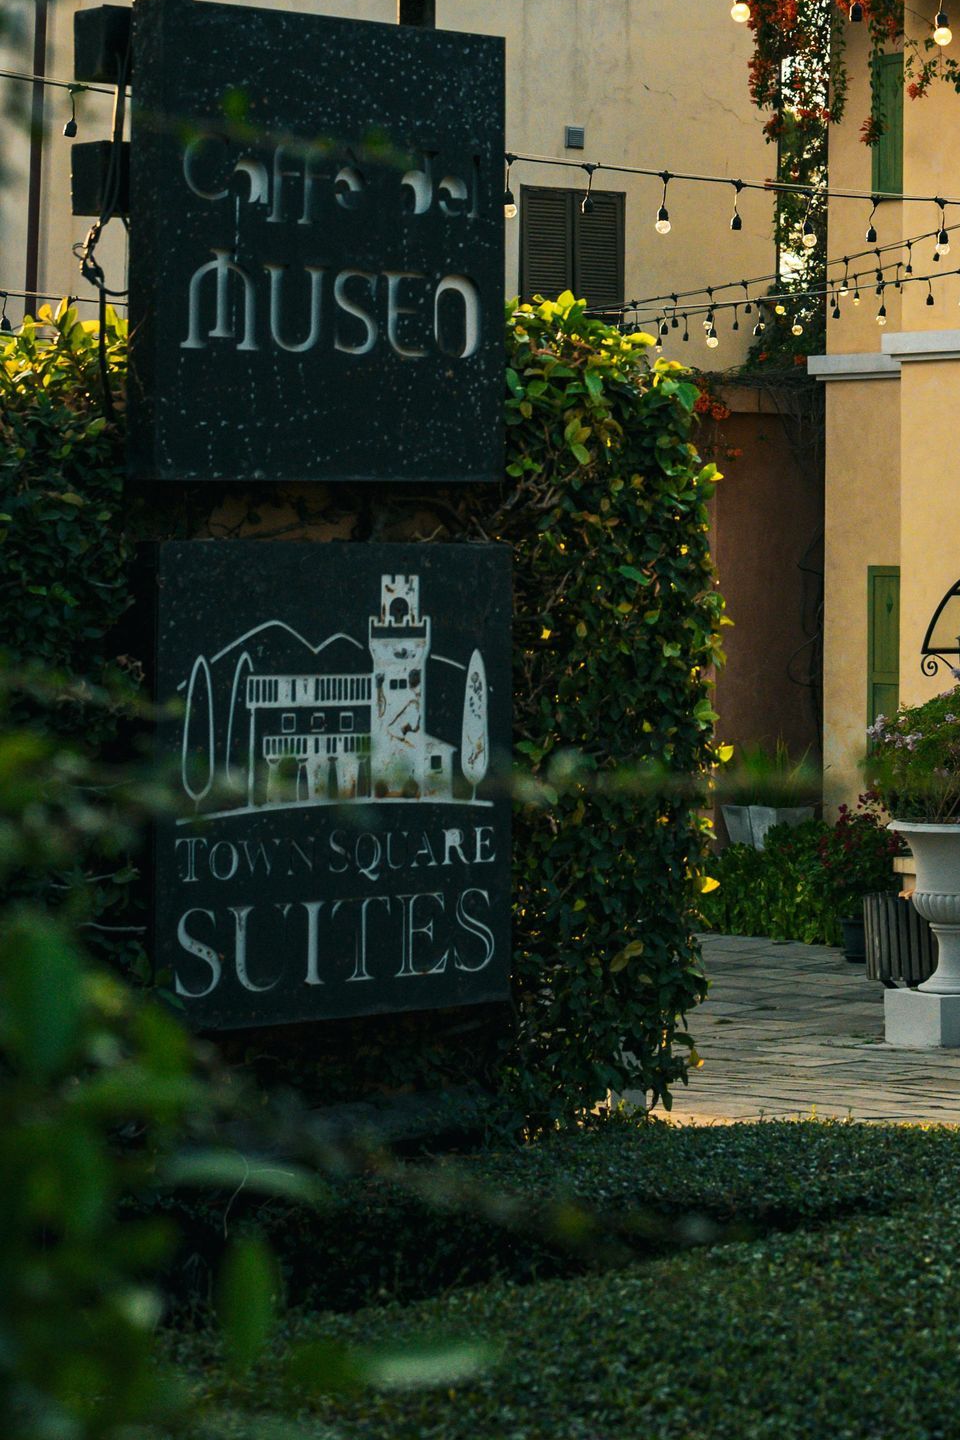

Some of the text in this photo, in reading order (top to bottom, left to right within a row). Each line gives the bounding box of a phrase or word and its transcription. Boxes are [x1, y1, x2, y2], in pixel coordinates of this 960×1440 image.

[400, 150, 482, 219] del
[180, 248, 483, 360] MUSEO
[174, 825, 497, 883] TOWN SQUARE
[174, 887, 496, 998] SUITES
